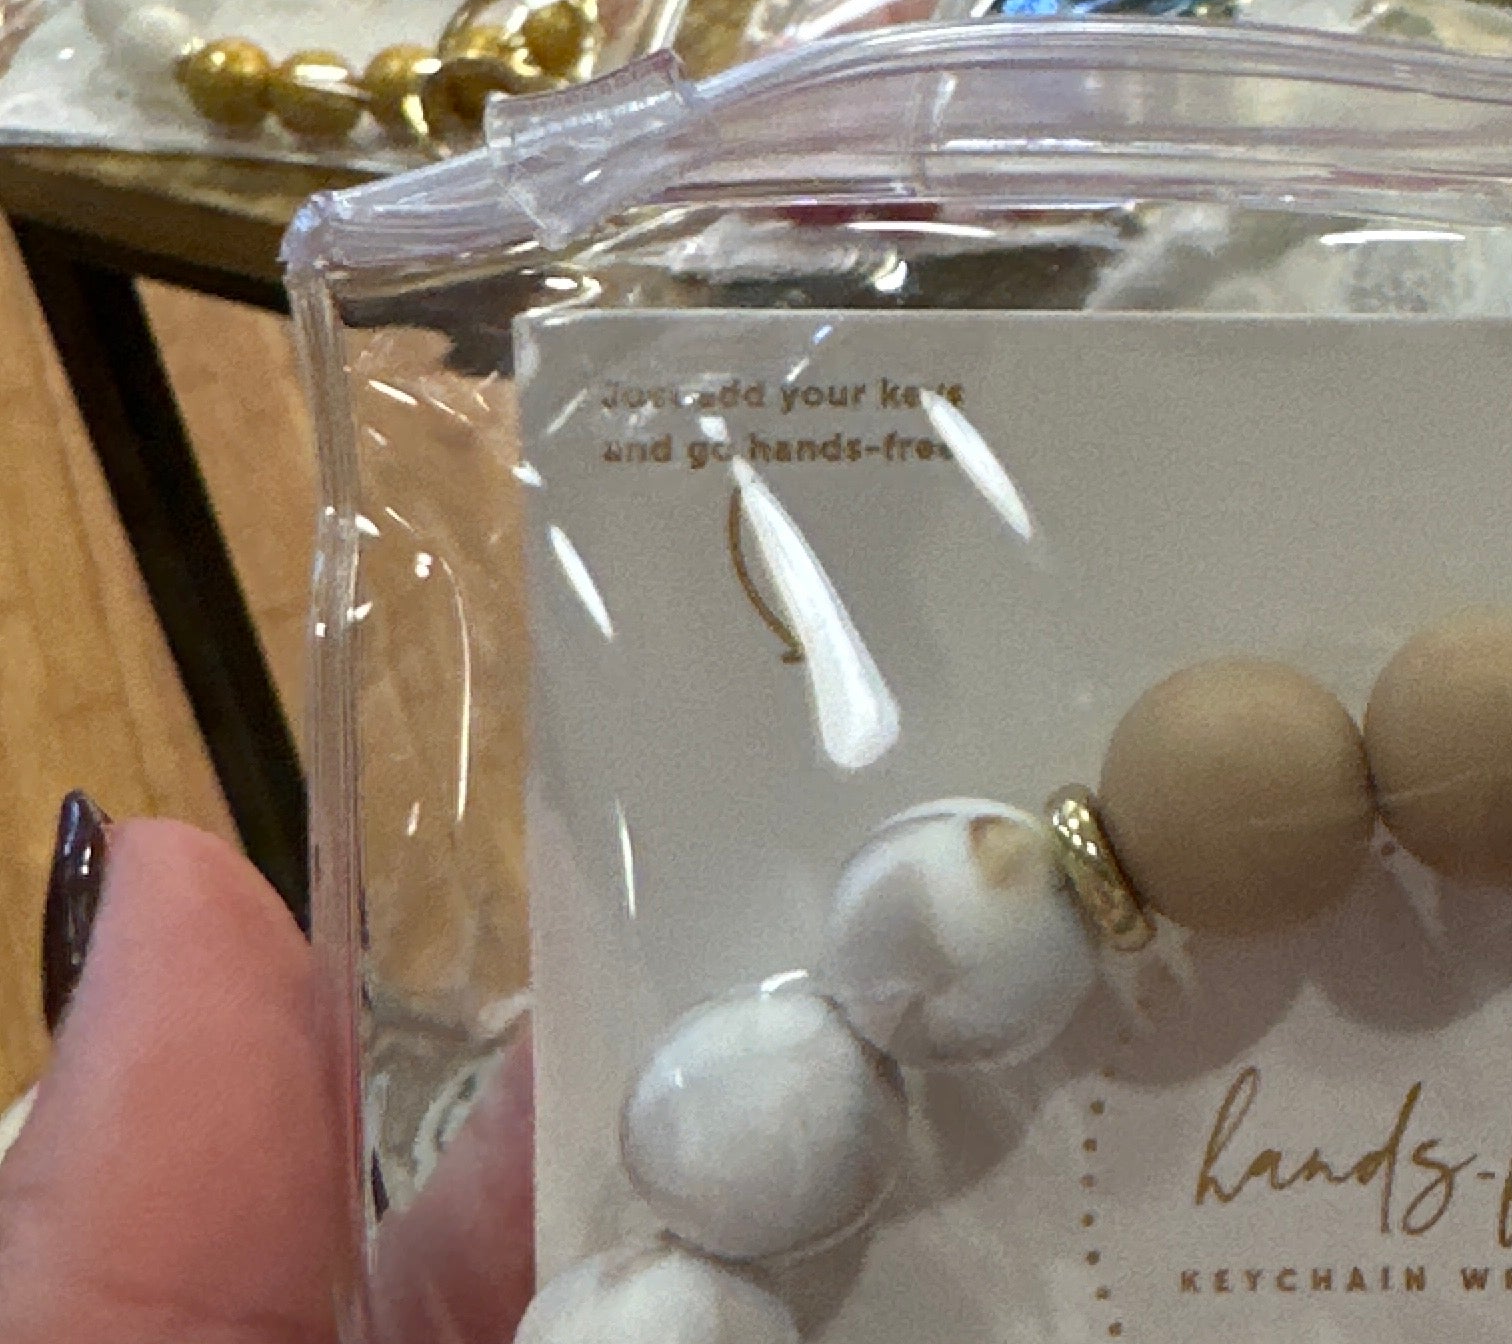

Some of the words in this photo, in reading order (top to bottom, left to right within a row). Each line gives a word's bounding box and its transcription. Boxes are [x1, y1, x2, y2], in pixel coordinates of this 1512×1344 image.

[781, 383, 866, 415] your
[603, 434, 672, 462] and
[687, 441, 735, 470] go
[1180, 1268, 1428, 1293] KEYCHAIN
